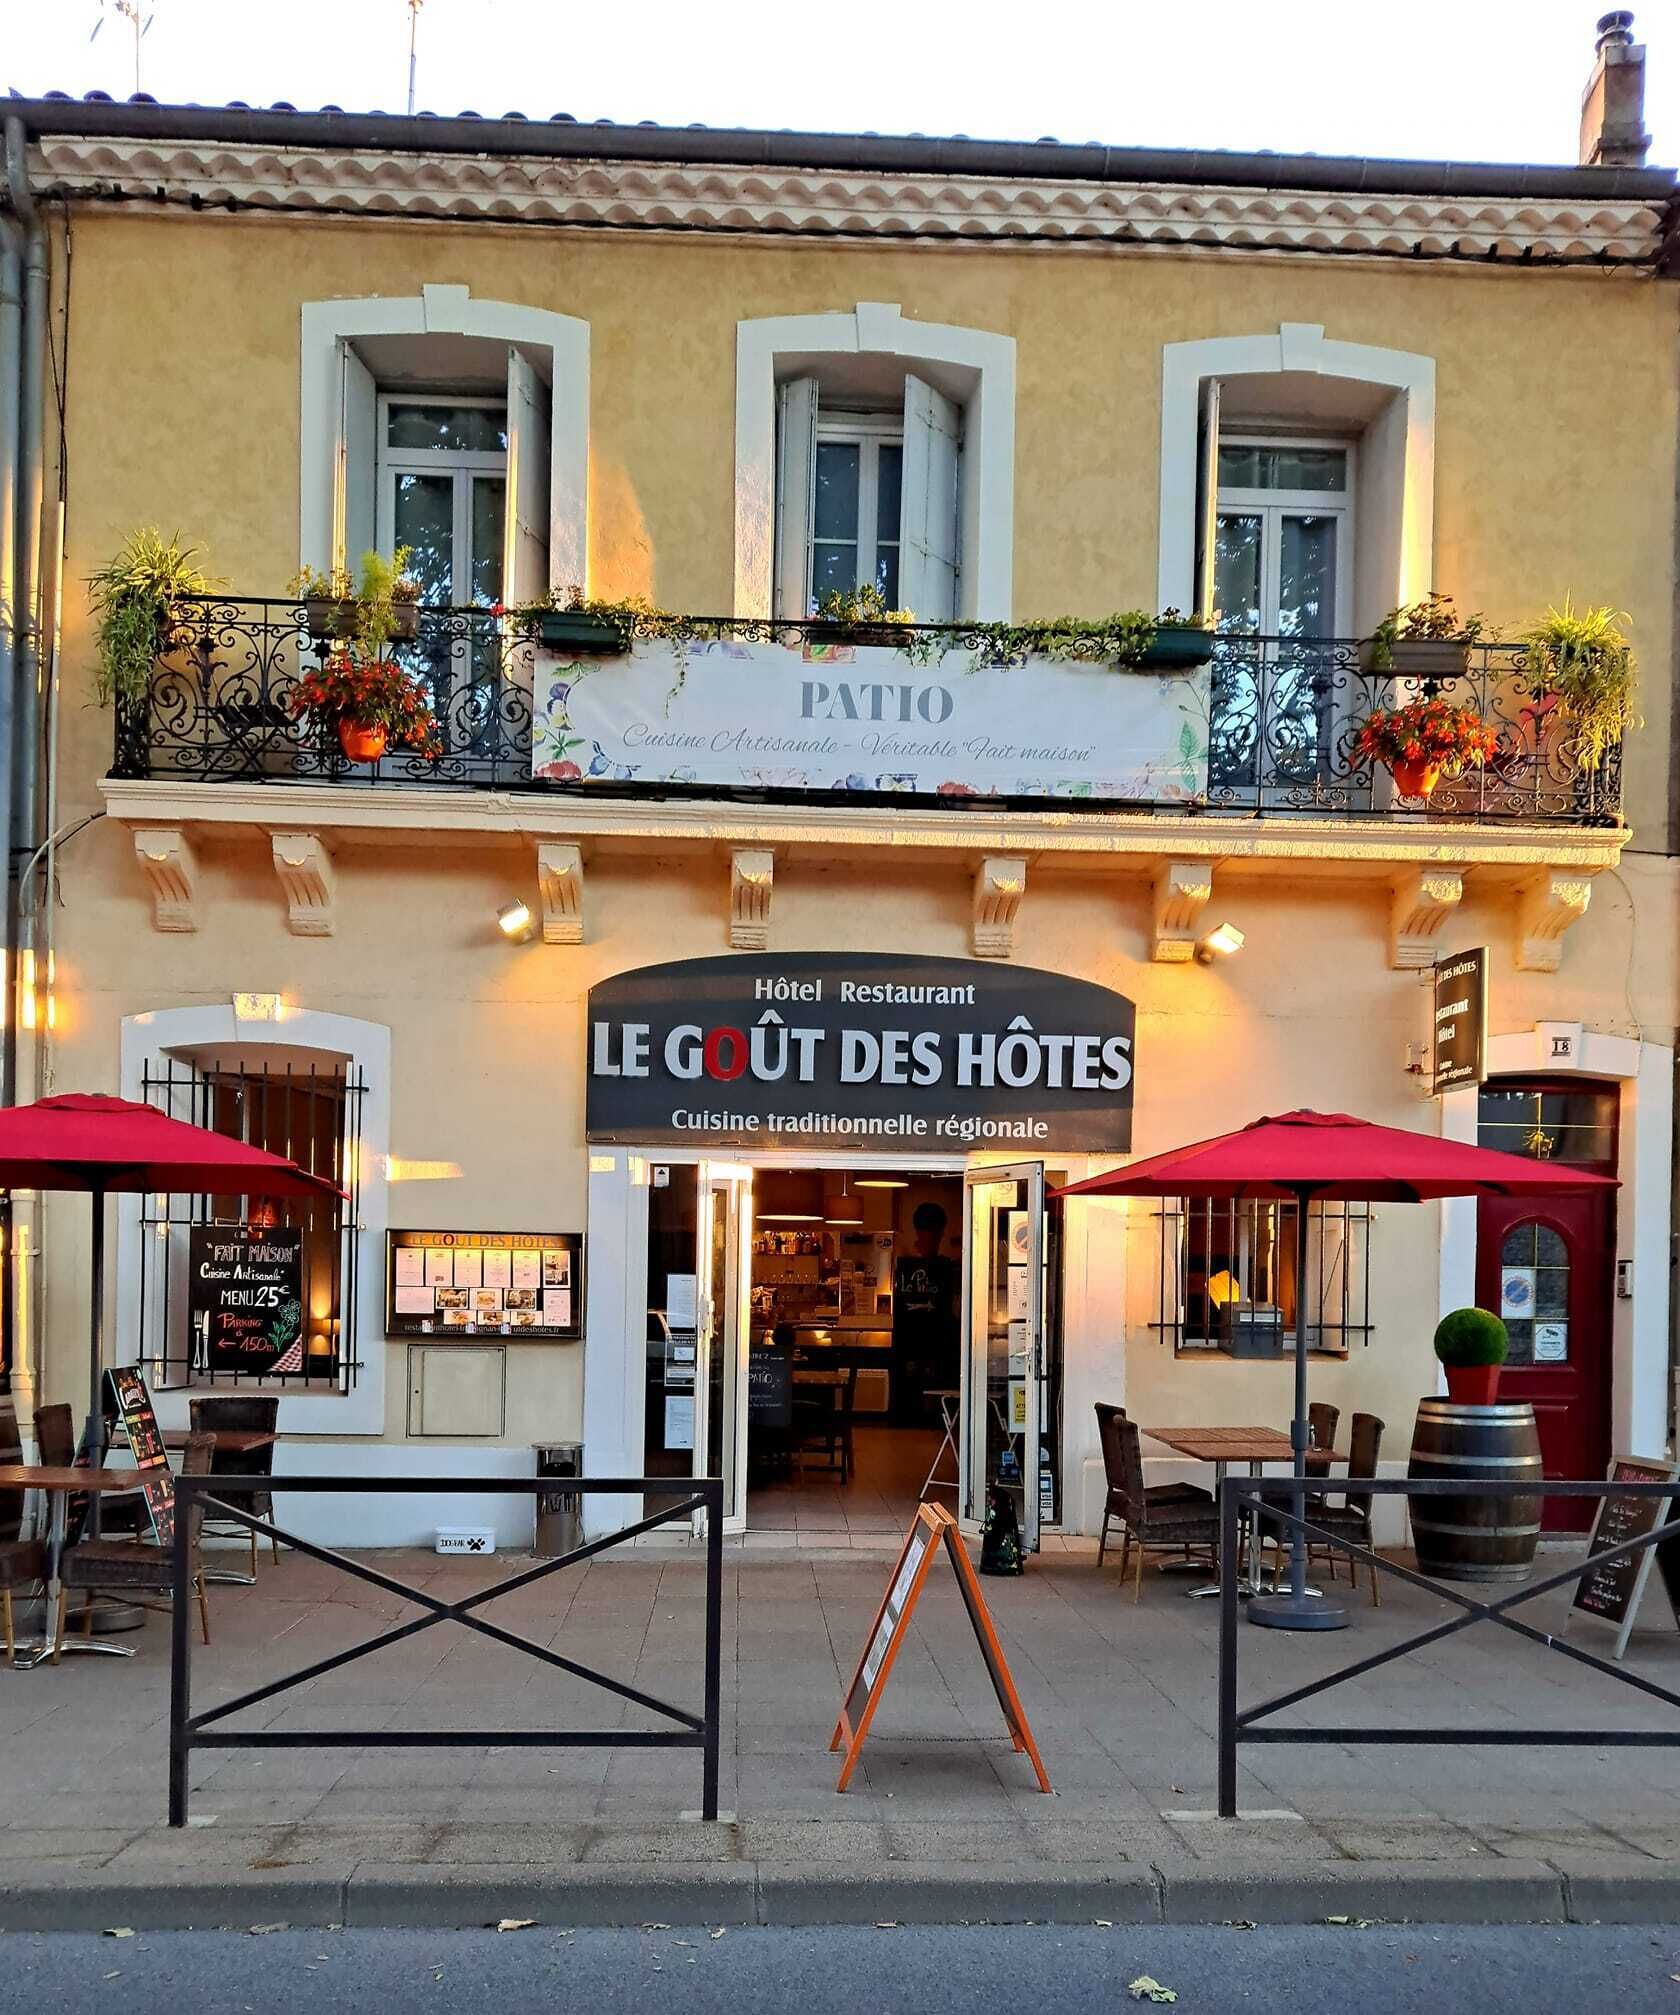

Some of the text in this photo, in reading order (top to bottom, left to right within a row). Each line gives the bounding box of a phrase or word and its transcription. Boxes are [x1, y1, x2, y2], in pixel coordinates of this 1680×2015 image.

[800, 681, 954, 724] PATIO
[623, 723, 706, 748] Cuisine
[711, 727, 840, 754] Artisanale
[860, 732, 958, 759] Véritable
[754, 978, 976, 1005] Hôtel Restaurant
[592, 1009, 1132, 1091] LE GOÛT DES HÔTES
[1554, 1040, 1569, 1052] 18
[671, 1108, 1049, 1142] Cuisine traditionnelle régionale
[200, 1262, 231, 1279] Cuisine
[220, 1289, 253, 1306] MENU
